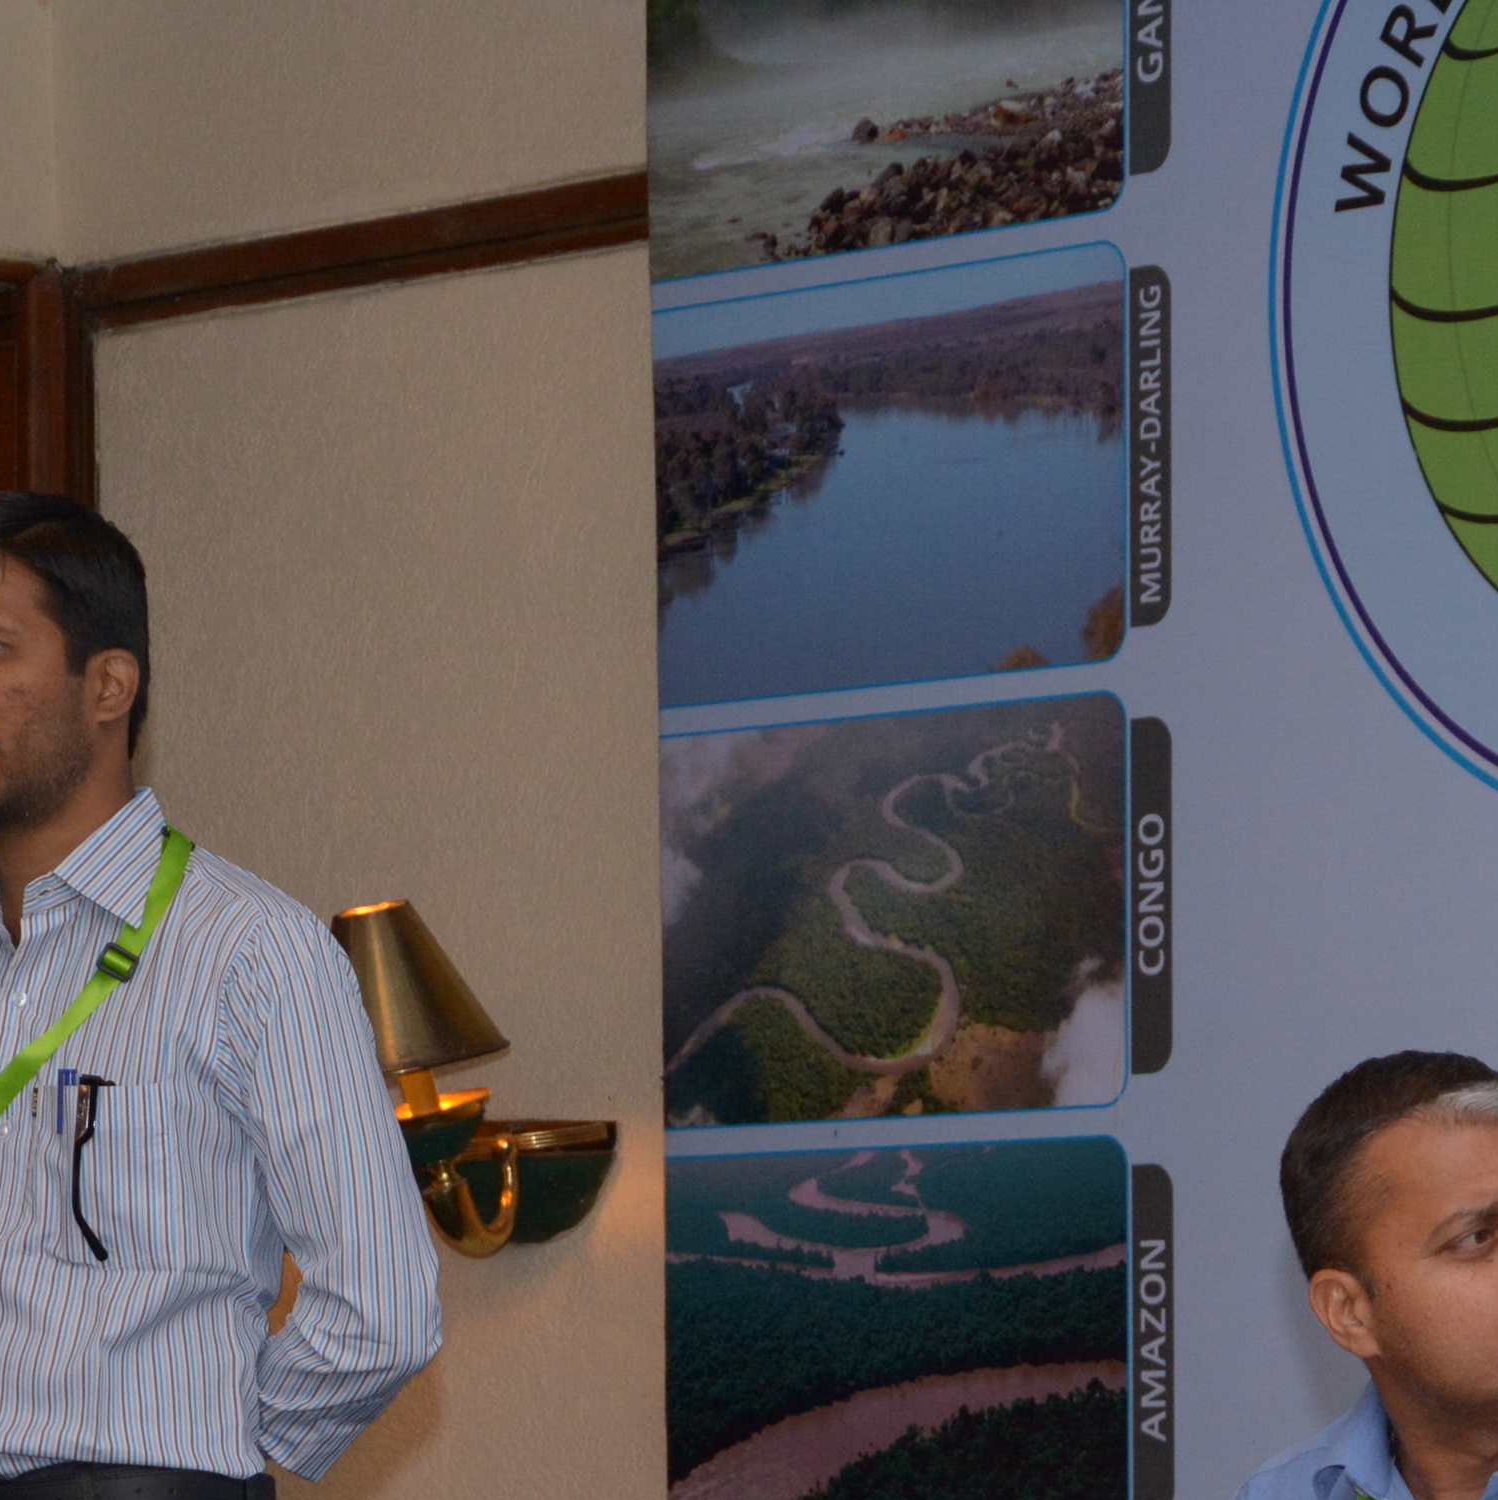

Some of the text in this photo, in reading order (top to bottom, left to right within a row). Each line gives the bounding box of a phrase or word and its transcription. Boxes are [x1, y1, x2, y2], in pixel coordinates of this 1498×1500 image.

[1137, 0, 1163, 83] GAN
[1334, 0, 1452, 213] WOR
[1139, 284, 1162, 604] MURRAY-DARLING
[1138, 812, 1165, 976] CONGO
[1140, 1238, 1167, 1442] AMAZON
